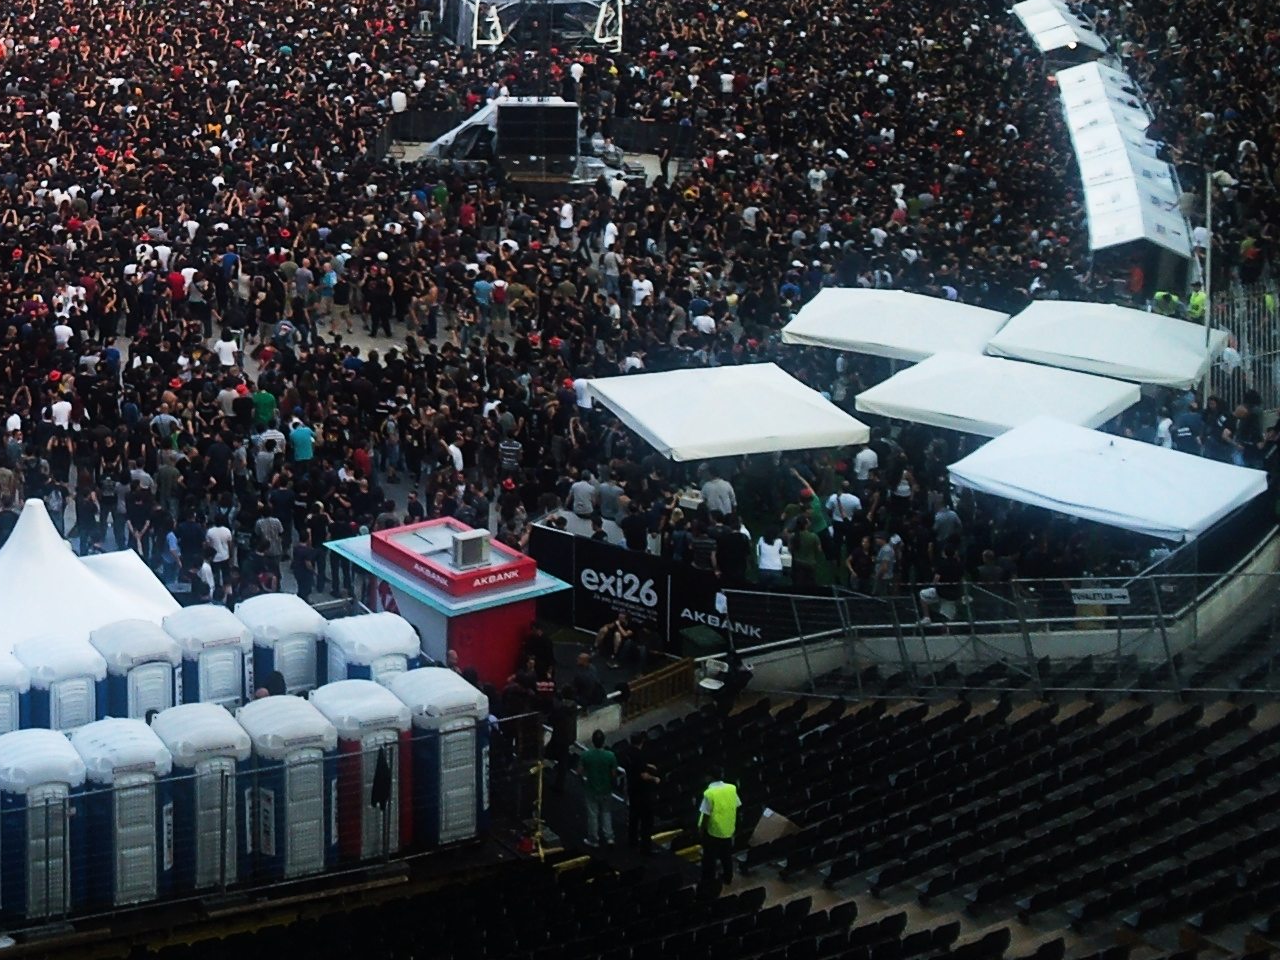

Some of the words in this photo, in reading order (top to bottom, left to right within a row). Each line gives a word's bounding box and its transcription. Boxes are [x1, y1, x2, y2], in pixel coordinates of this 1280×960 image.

[472, 569, 519, 588] AKBANK
[581, 568, 659, 607] exi26
[680, 608, 762, 640] AKBANK
